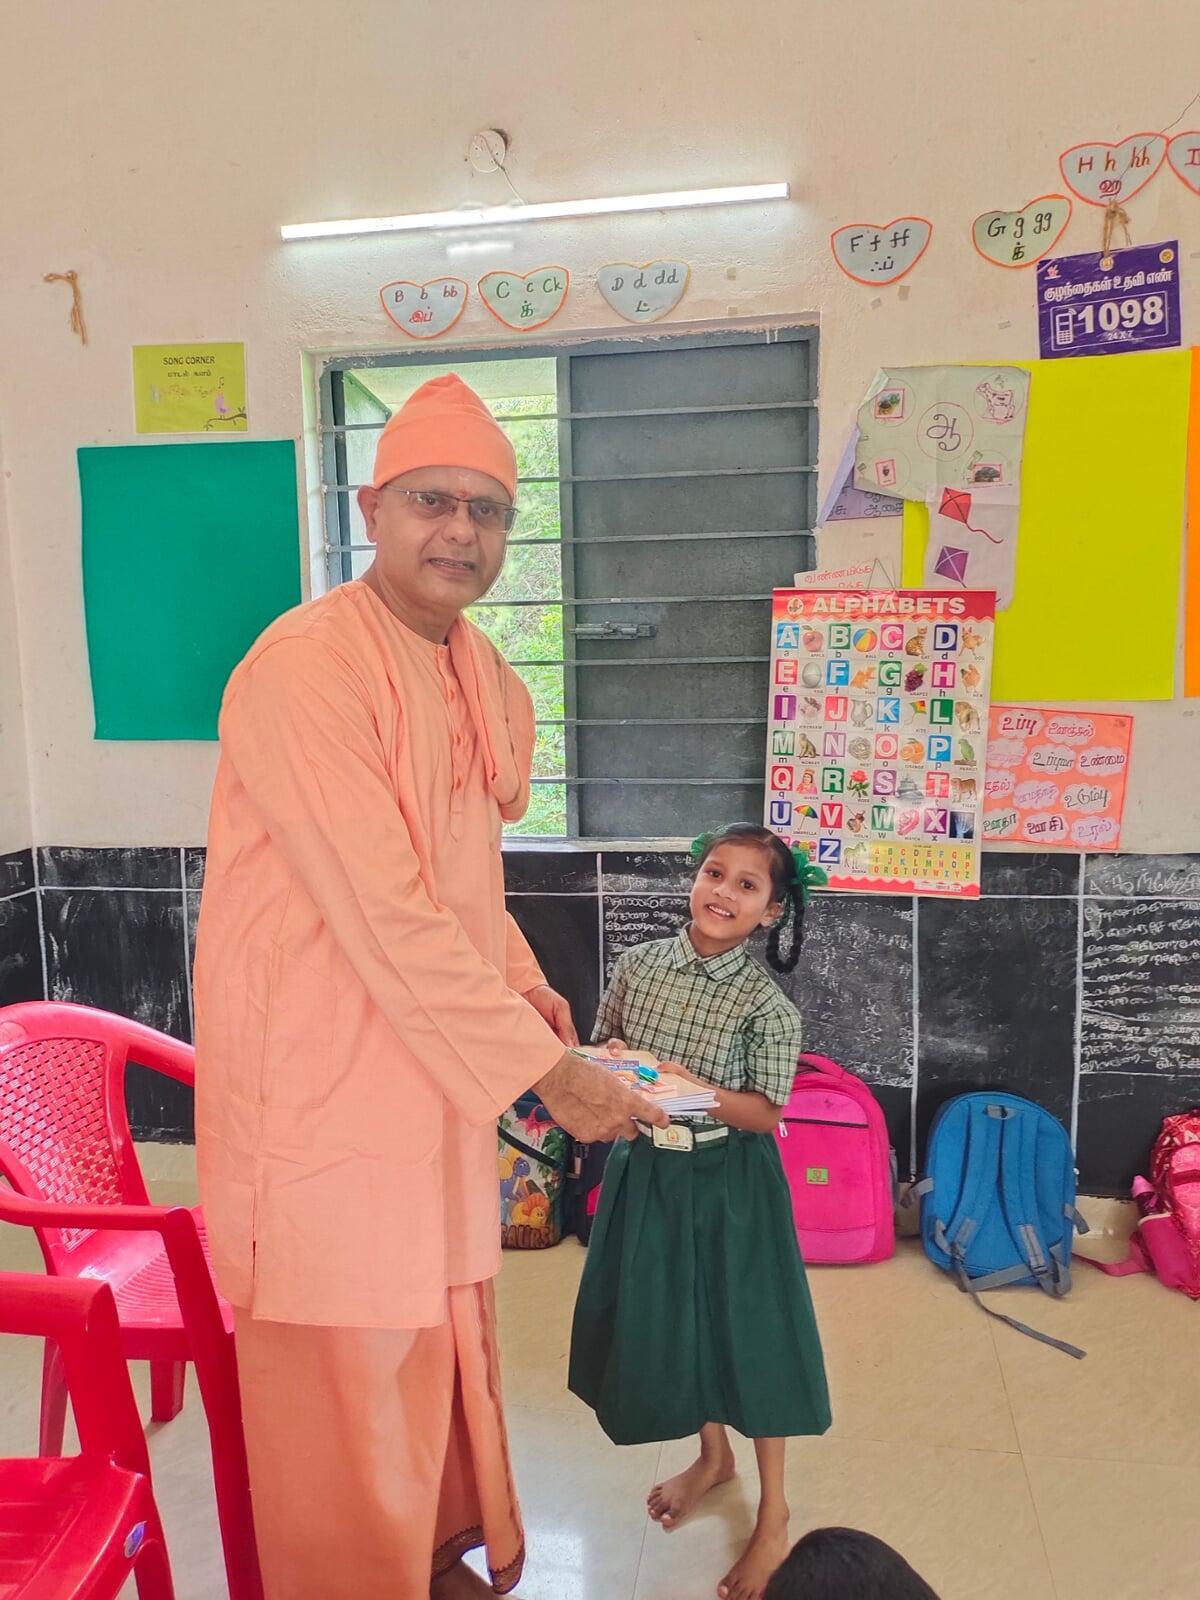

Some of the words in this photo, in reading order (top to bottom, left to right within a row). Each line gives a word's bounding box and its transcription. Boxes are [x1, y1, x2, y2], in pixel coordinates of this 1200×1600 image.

[1078, 157, 1093, 173] H
[1104, 152, 1116, 171] h
[988, 218, 1006, 237] G
[1014, 218, 1024, 238] g
[1033, 213, 1052, 234] gg
[851, 235, 863, 252] F
[870, 235, 880, 251] f
[890, 229, 910, 248] ff
[496, 281, 510, 298] C
[527, 283, 534, 292] c
[612, 277, 623, 291] D
[634, 272, 647, 288] d
[654, 269, 678, 284] dd
[1044, 276, 1112, 301] குழந்தைகள்
[1113, 271, 1144, 291] உதவி
[1147, 268, 1172, 284] எண்
[395, 290, 404, 302] B
[420, 288, 428, 299] b
[444, 286, 457, 297] bb
[1078, 296, 1164, 334] 1098
[163, 357, 183, 365] SONG
[186, 356, 215, 365] CORNER
[926, 414, 961, 452] ஆ
[812, 597, 966, 614] ALPHABETS
[778, 626, 798, 648] A
[831, 626, 849, 647] B
[882, 626, 901, 648] C
[935, 626, 956, 649] D
[835, 650, 842, 658] b
[942, 651, 948, 660] d
[780, 662, 794, 683] E
[830, 662, 846, 683] F
[880, 663, 900, 685] G
[934, 664, 954, 686] H
[886, 688, 893, 696] g
[939, 689, 946, 697] h
[782, 698, 788, 718] I
[829, 698, 843, 720] J
[878, 699, 898, 721] K
[933, 702, 949, 722] L
[783, 721, 786, 729] i
[773, 733, 794, 753] M
[826, 734, 844, 756] N
[877, 735, 896, 758] O
[930, 738, 949, 759] P
[935, 762, 941, 770] p
[774, 768, 791, 790] Q
[825, 770, 842, 791] R
[876, 771, 894, 793] S
[928, 774, 947, 796] T
[772, 803, 791, 824] U
[822, 805, 841, 827] V
[872, 806, 895, 829] W
[926, 809, 946, 832] X
[820, 840, 839, 862] Z
